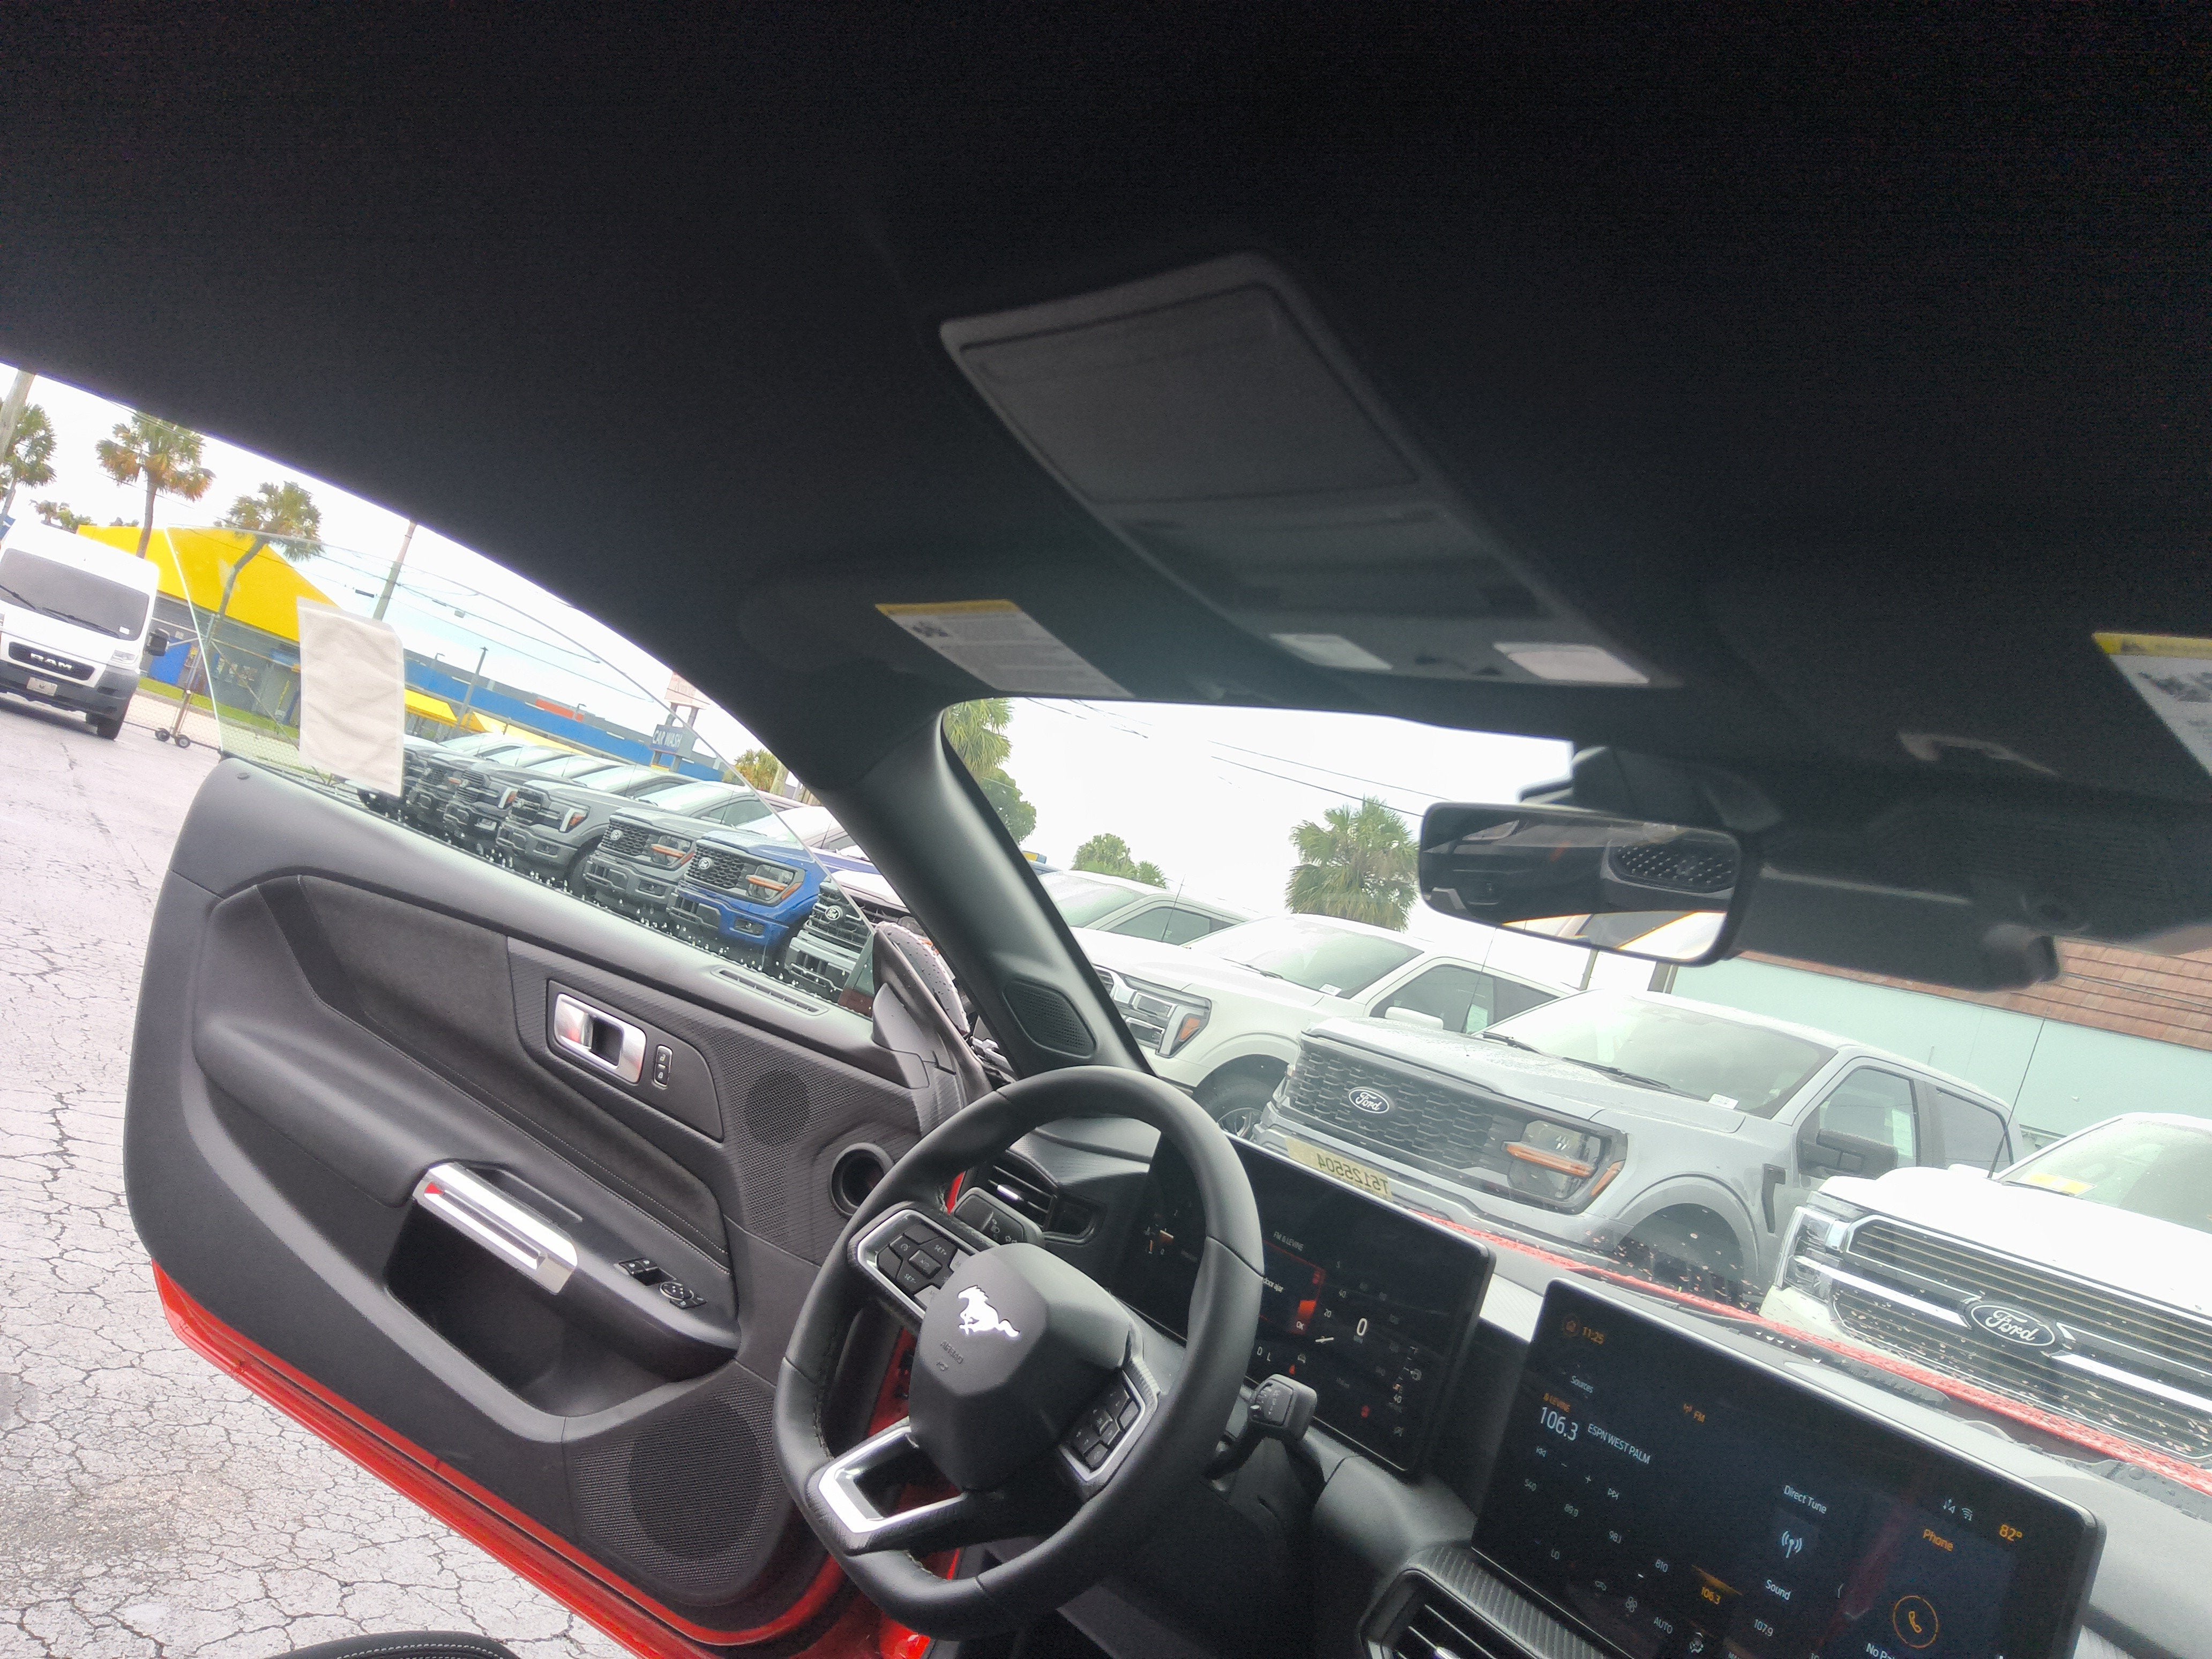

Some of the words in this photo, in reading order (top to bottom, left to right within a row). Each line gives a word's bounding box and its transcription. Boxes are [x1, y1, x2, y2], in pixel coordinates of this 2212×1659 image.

[31, 653, 72, 671] RAM
[652, 730, 666, 745] CAR
[664, 732, 683, 748] WASH
[1355, 1092, 1382, 1111] Ford
[1296, 1321, 1305, 1331] OK
[1356, 1318, 1367, 1336] 0
[1985, 1310, 2039, 1341] Ford
[1570, 1376, 1594, 1393] Sources
[1540, 1407, 1579, 1441] 106.3
[1588, 1423, 1608, 1441] ESPN
[1607, 1433, 1630, 1453] WEST
[1628, 1445, 1651, 1464] PALM
[1784, 1485, 1807, 1504] Direct
[1807, 1496, 1827, 1515] Tune
[1923, 1528, 1954, 1552] Phone
[1766, 1579, 1791, 1601] Sound
[1653, 1617, 1673, 1634] AUTO
[1754, 1619, 1774, 1637] 107.9
[1866, 1642, 1879, 1657] No
